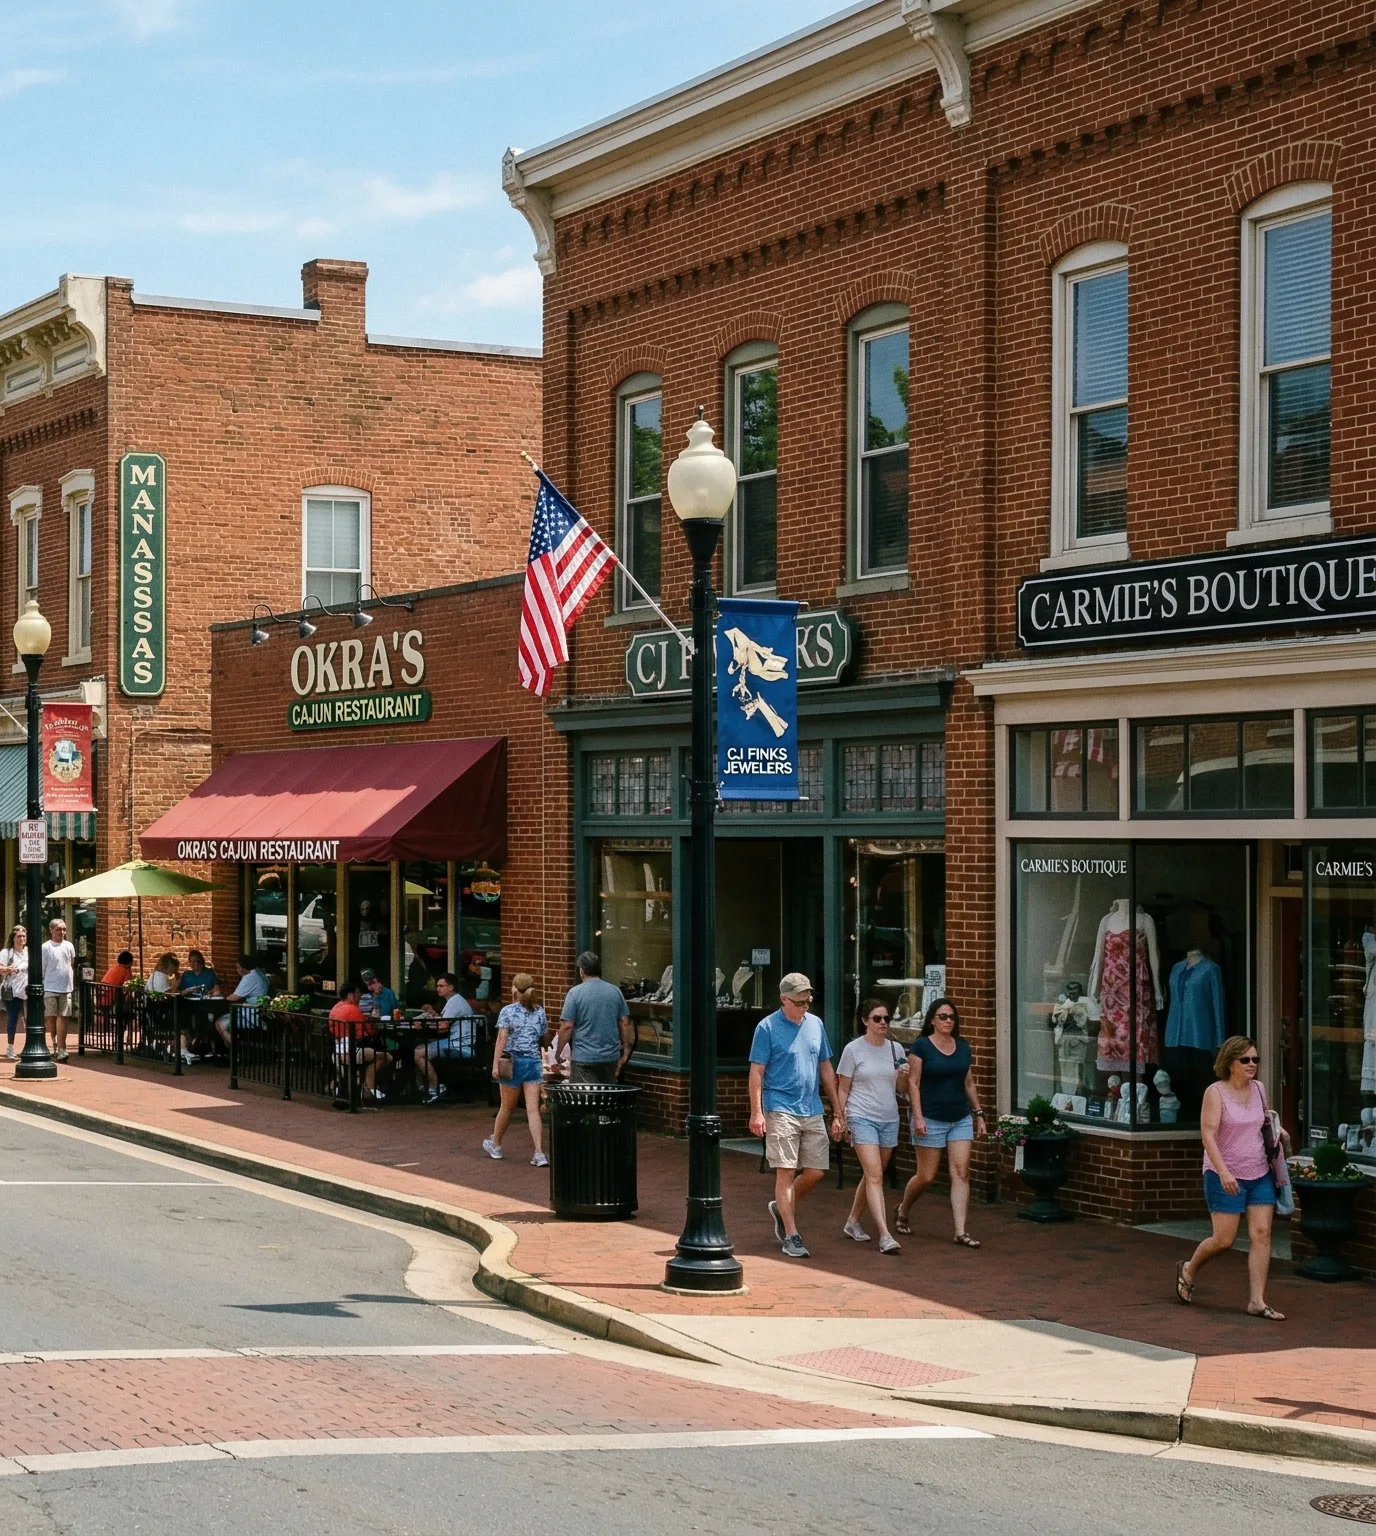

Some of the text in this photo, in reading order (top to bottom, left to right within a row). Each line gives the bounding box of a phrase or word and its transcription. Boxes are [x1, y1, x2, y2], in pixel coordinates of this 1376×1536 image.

[130, 464, 157, 684] MANASSAS
[1030, 554, 1376, 631] CARMIE'S BOUTIQUE
[290, 629, 425, 696] OKRA'S
[636, 640, 669, 690] CJ
[292, 694, 422, 726] CAJUN RESTAURANT
[727, 748, 788, 761] CJ FINKS
[723, 761, 793, 775] JEWELERS
[177, 840, 340, 861] OKRA'S CAJUN RESTAURANT
[1020, 858, 1128, 878] CARMIE'S BOUTIQUE
[1315, 860, 1374, 877] CARMIE'S
